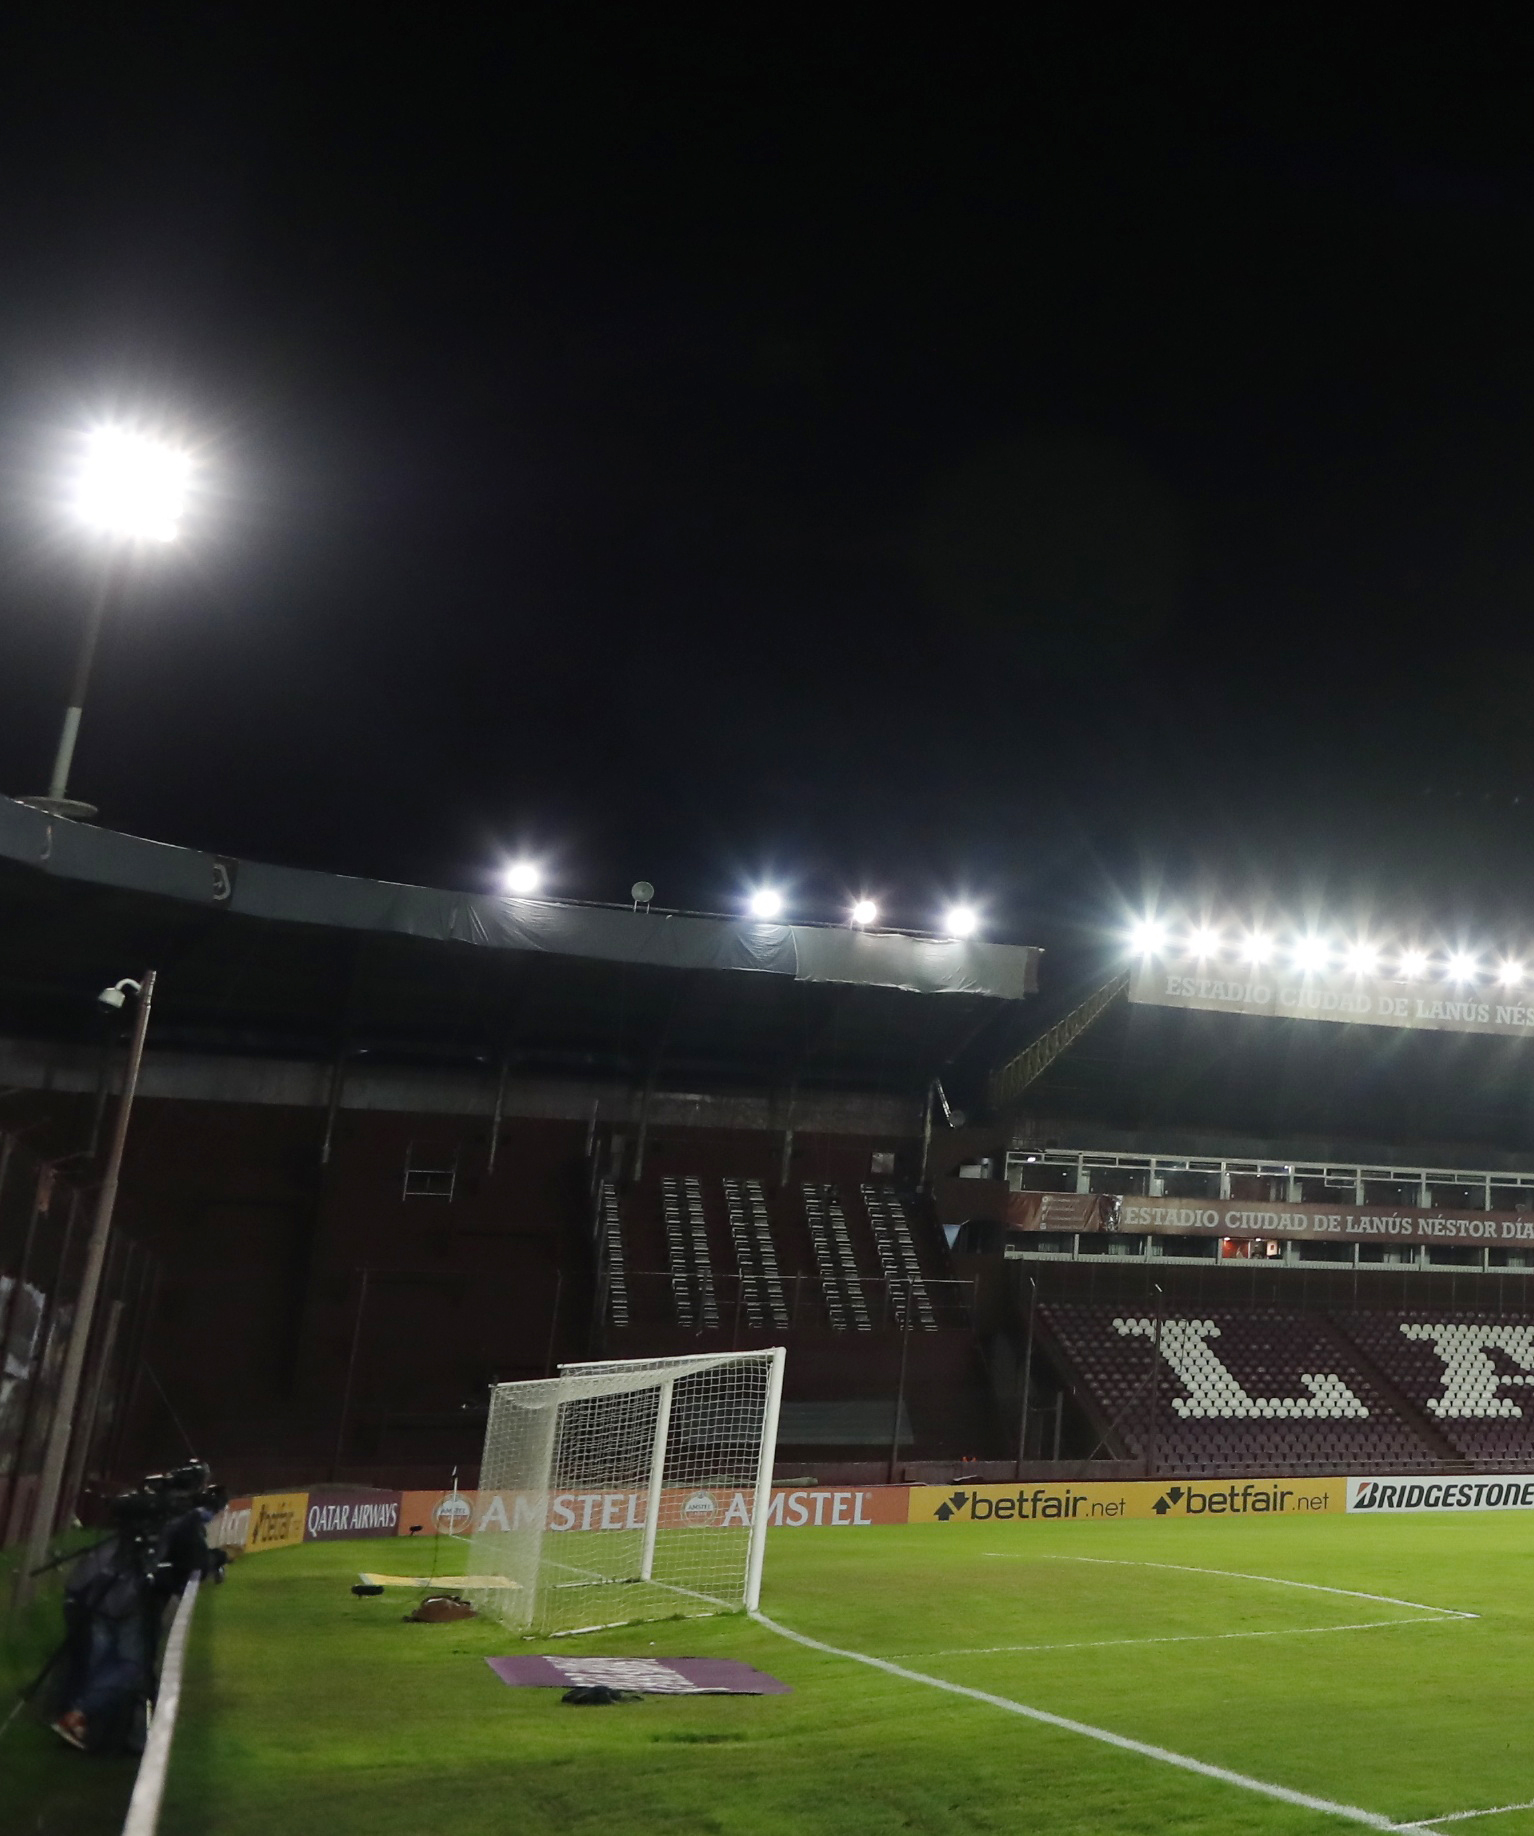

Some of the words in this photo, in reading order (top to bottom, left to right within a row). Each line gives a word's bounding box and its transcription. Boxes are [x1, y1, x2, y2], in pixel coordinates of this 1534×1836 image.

[1165, 975, 1272, 1005] ESTADIO
[1278, 987, 1371, 1014] CIUDAD
[1378, 998, 1409, 1017] DE
[1415, 997, 1490, 1023] LANÚS
[1124, 1206, 1219, 1228] ESTADIO
[1224, 1210, 1308, 1231] CIUDAD
[1313, 1215, 1341, 1232] DE
[1346, 1211, 1412, 1235] LANÚS
[1417, 1214, 1497, 1239] NÉSTOR
[969, 1489, 1126, 1520] betfair.net
[1186, 1484, 1330, 1514] betfair.net
[307, 1504, 348, 1537] QATAR
[351, 1502, 398, 1531] AIRWAYS
